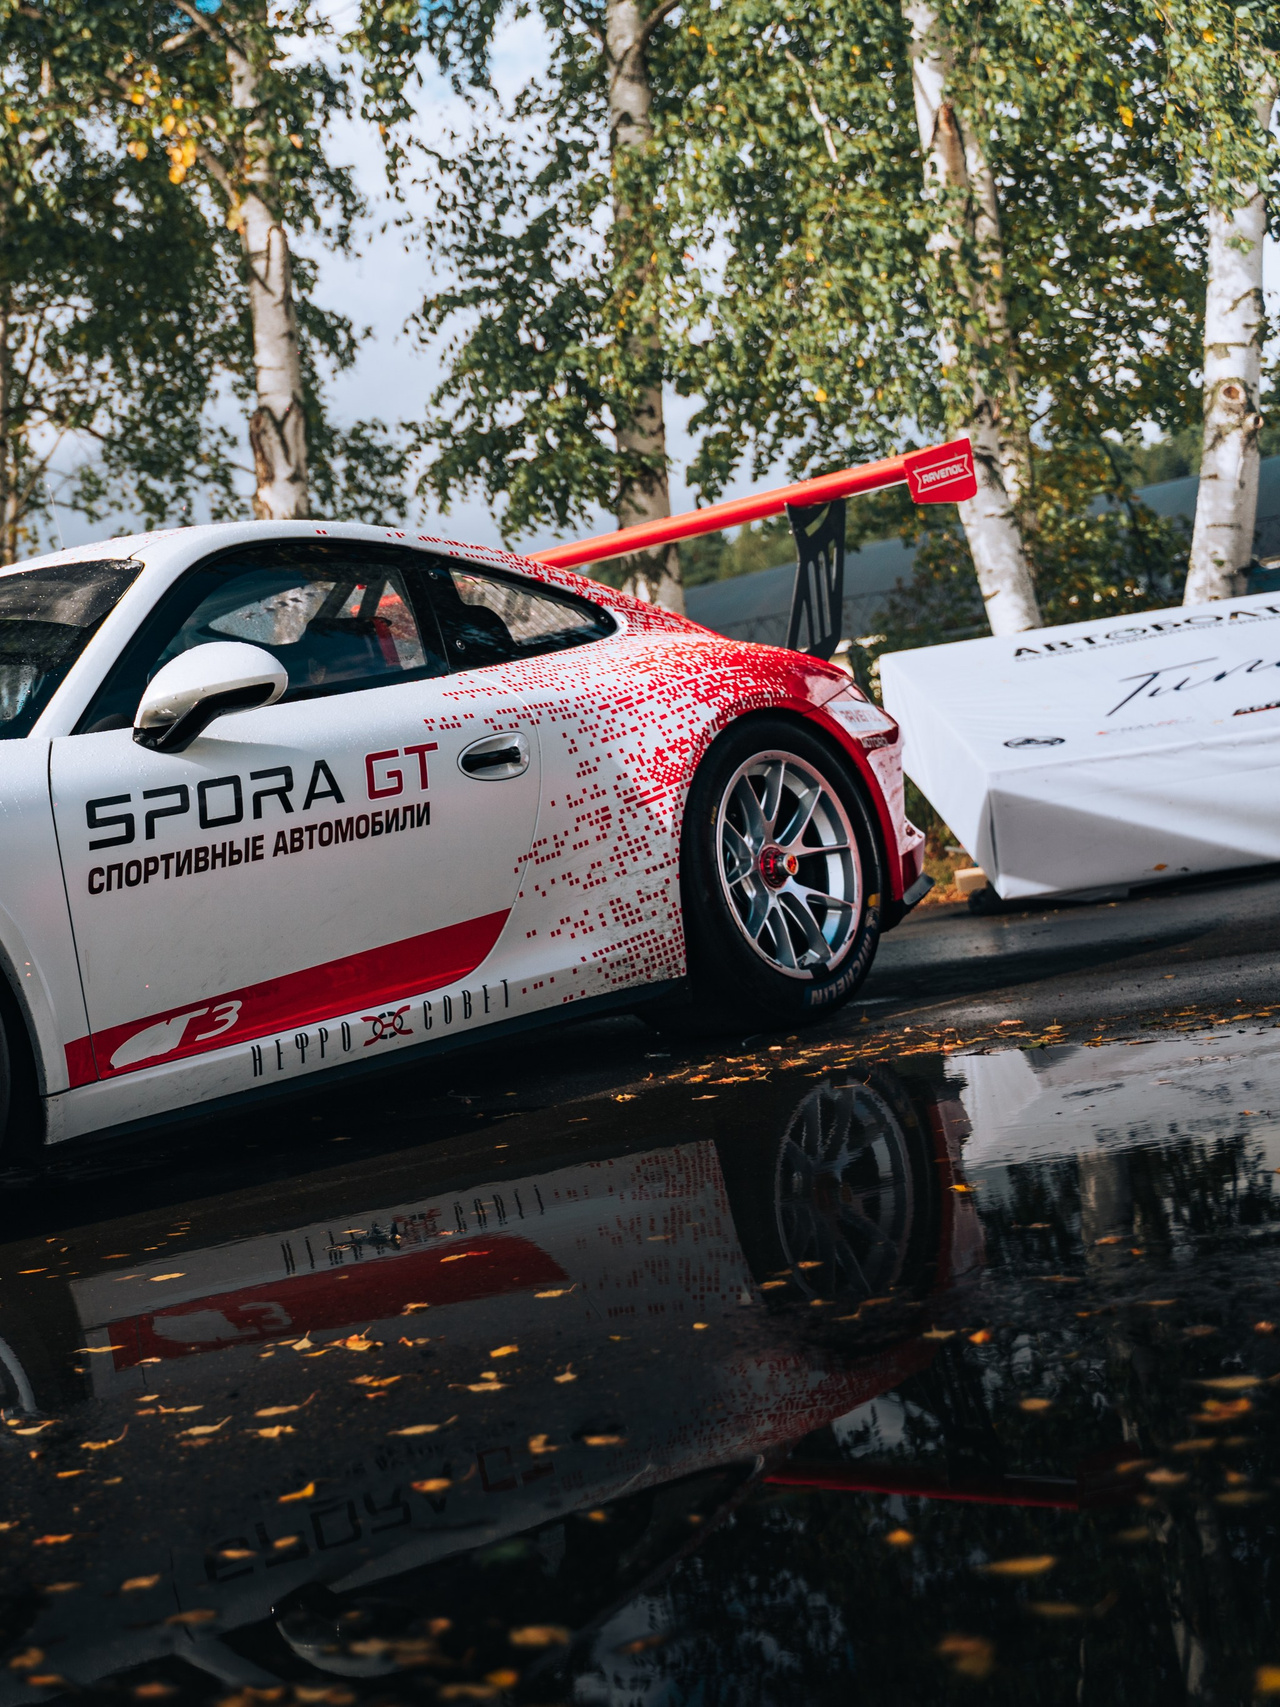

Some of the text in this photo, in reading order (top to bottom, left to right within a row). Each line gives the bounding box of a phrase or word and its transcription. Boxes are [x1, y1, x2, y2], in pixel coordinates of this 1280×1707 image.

[922, 463, 964, 484] RAVENOL
[86, 741, 439, 851] SPORA GT
[88, 801, 430, 895] СПОРТИВНЫЕ АВТОМОБИЛИ
[811, 932, 872, 1006] MICHELIN
[250, 979, 508, 1077] НЕФРО СОВЕТ
